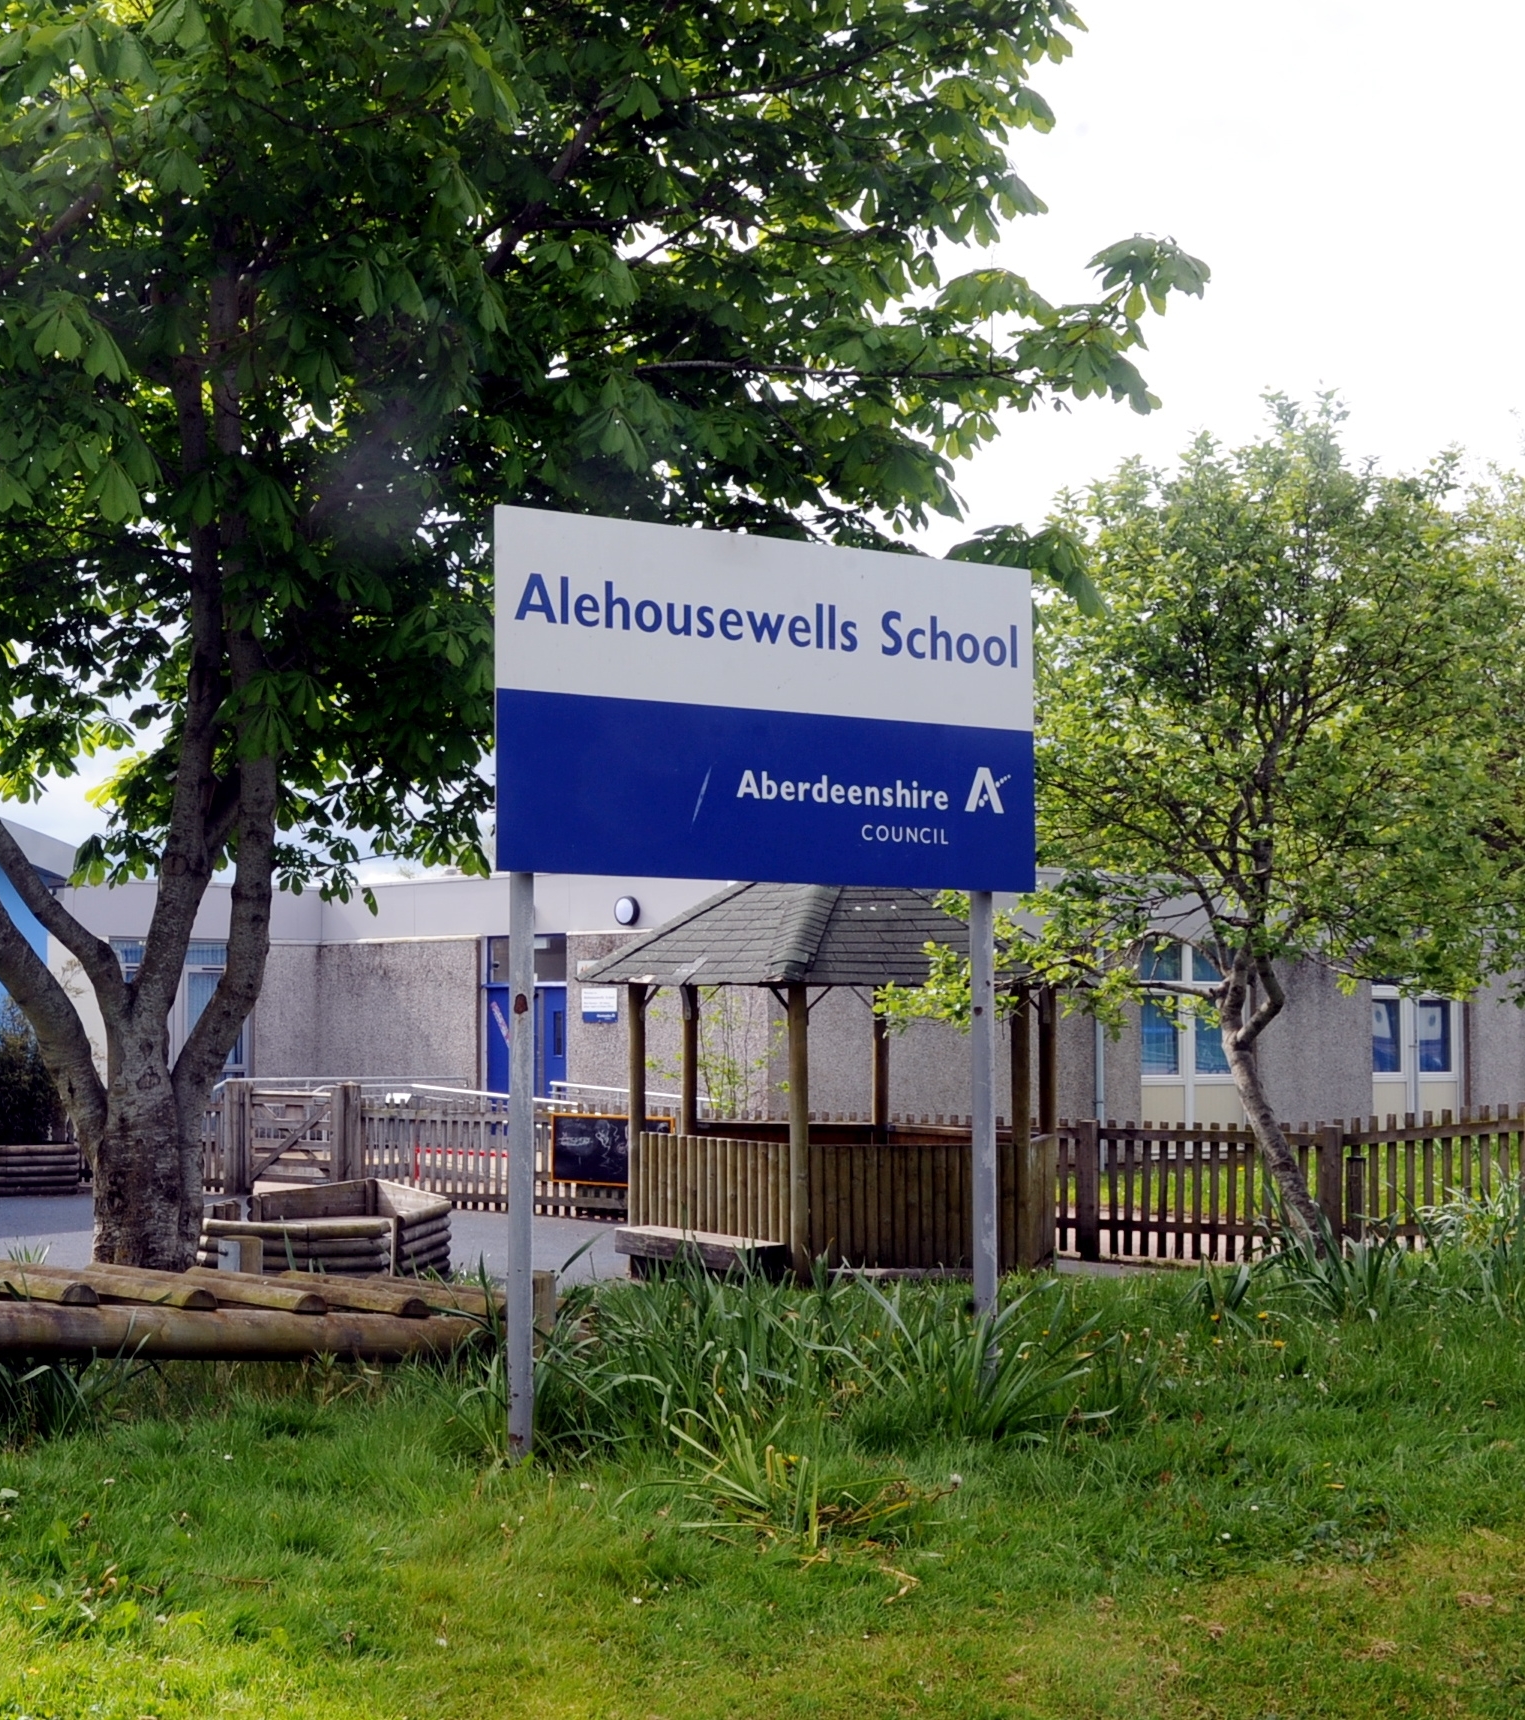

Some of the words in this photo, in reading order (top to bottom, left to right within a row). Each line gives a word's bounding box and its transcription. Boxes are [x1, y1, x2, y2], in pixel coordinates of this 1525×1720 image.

[514, 572, 858, 653] Alehousewells
[881, 610, 1018, 669] School
[736, 769, 949, 811] Aberdeenshire
[861, 824, 949, 845] COUNCIL
